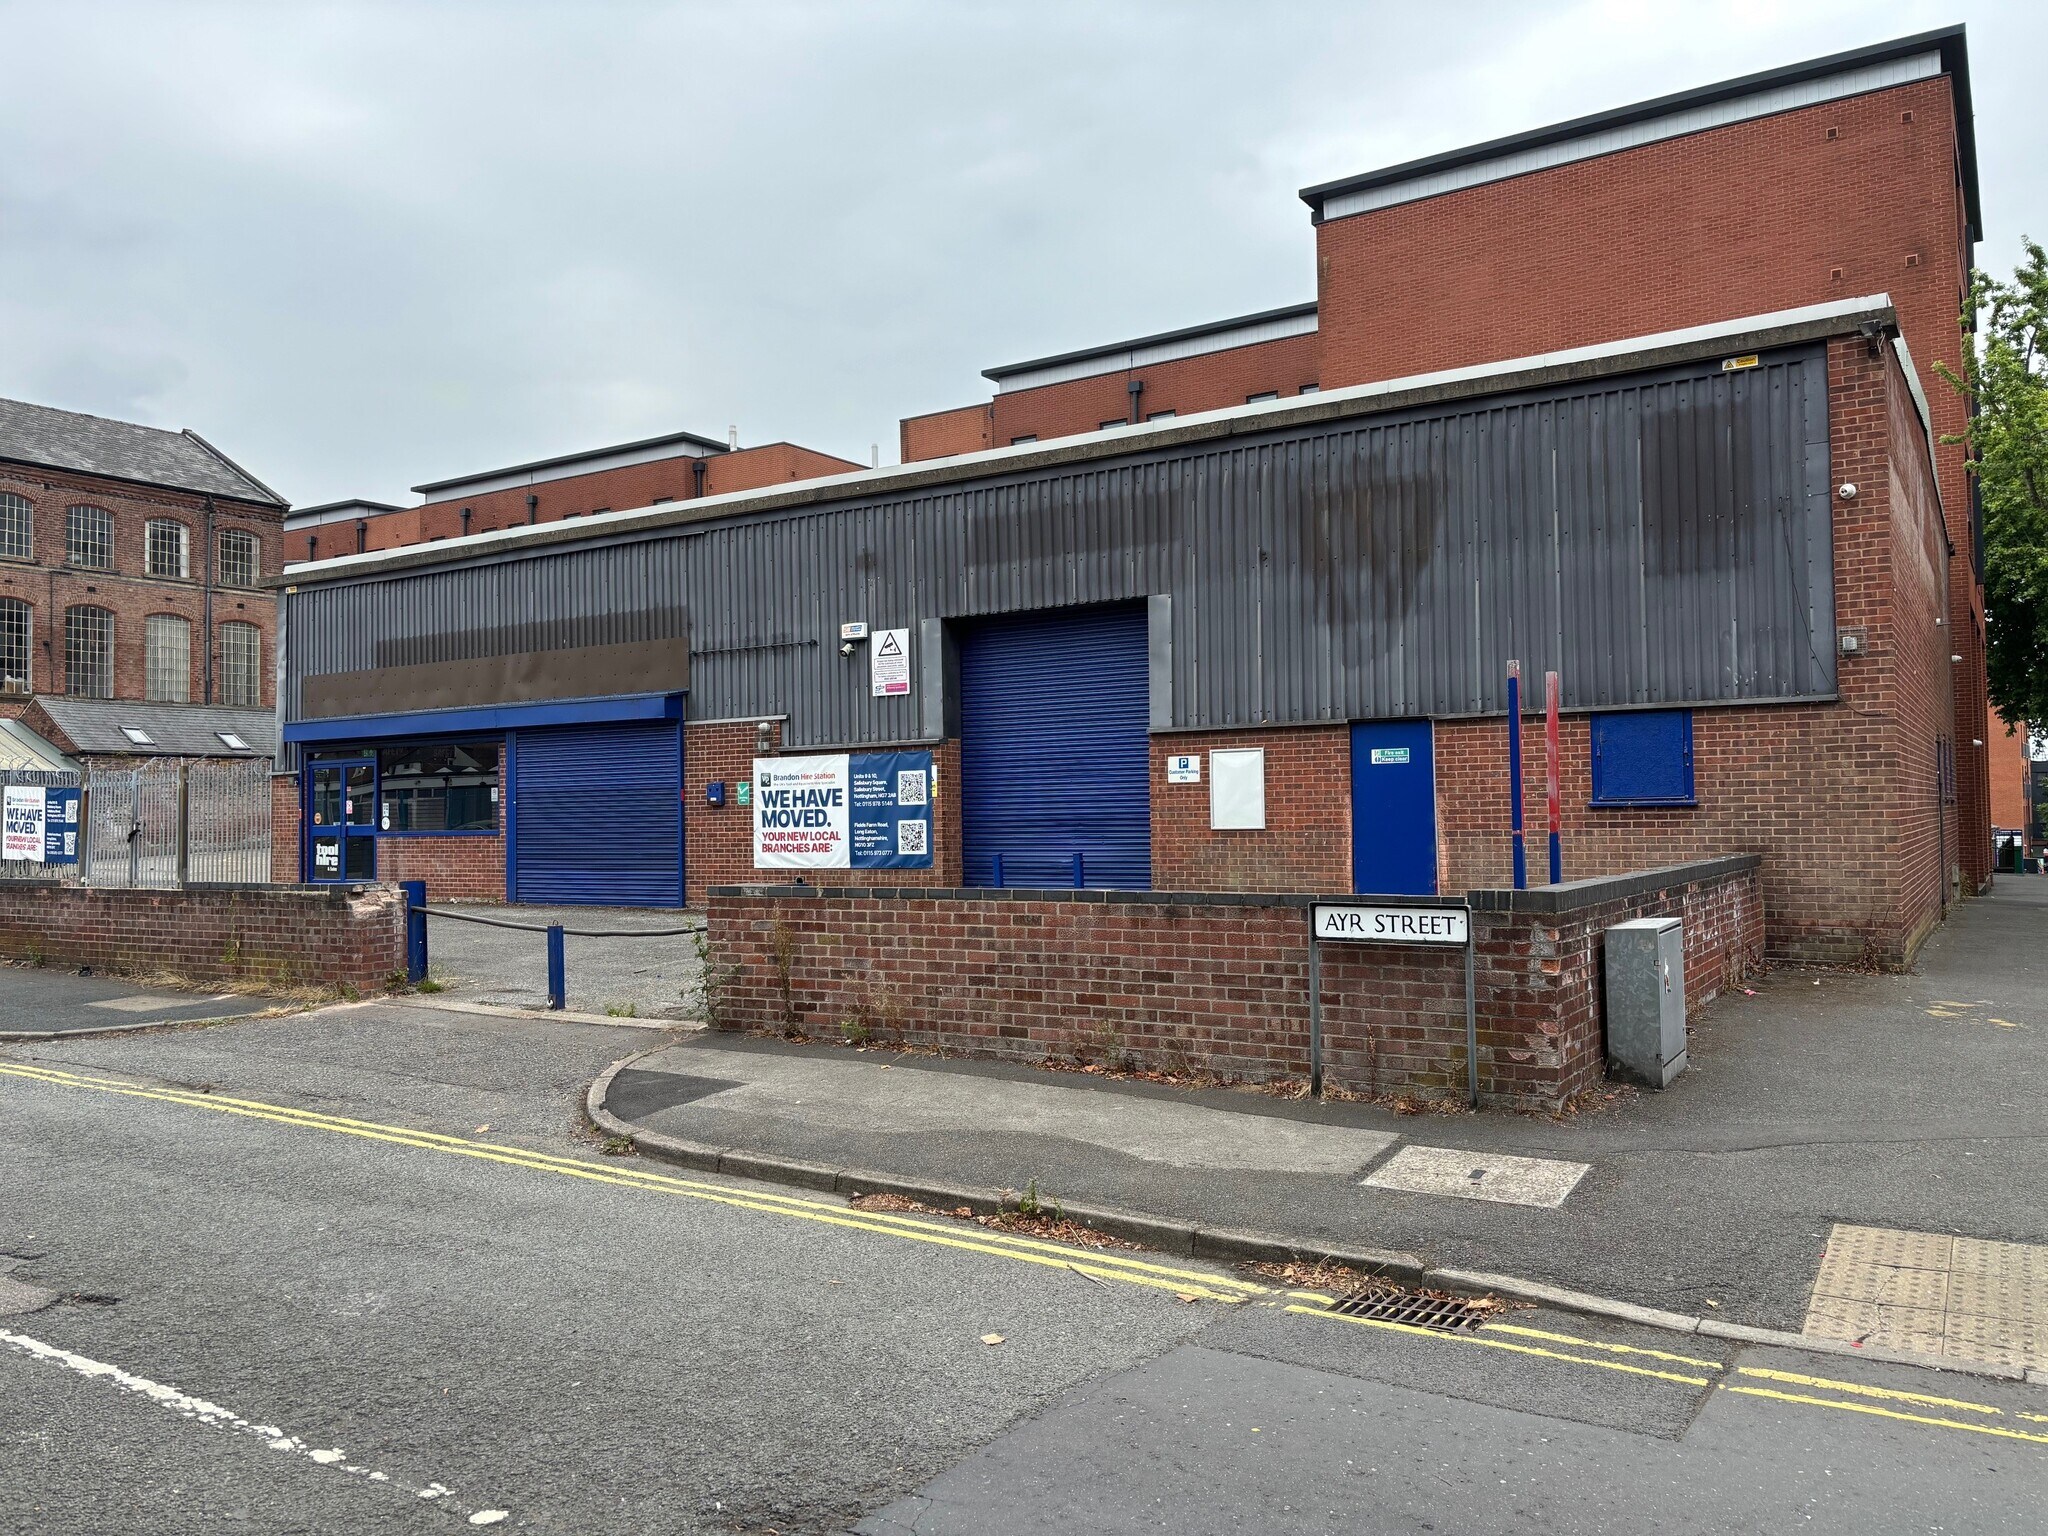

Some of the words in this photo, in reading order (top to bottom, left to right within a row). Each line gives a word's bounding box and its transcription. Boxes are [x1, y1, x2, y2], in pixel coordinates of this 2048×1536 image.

[761, 790, 790, 808] WE
[792, 788, 842, 808] HAVE
[7, 808, 19, 820] WE
[20, 809, 42, 821] HAVE
[762, 809, 831, 828] MOVED.
[6, 821, 37, 834] MOVED.
[762, 832, 786, 841] YOUR
[787, 831, 808, 841] NEW
[810, 831, 841, 841] LOCAL
[316, 844, 338, 855] tool
[762, 843, 810, 852] BRANCHES
[811, 843, 833, 852] ARE:
[316, 855, 338, 866] hire
[1325, 913, 1364, 932] AYR
[1374, 914, 1456, 935] STREET
